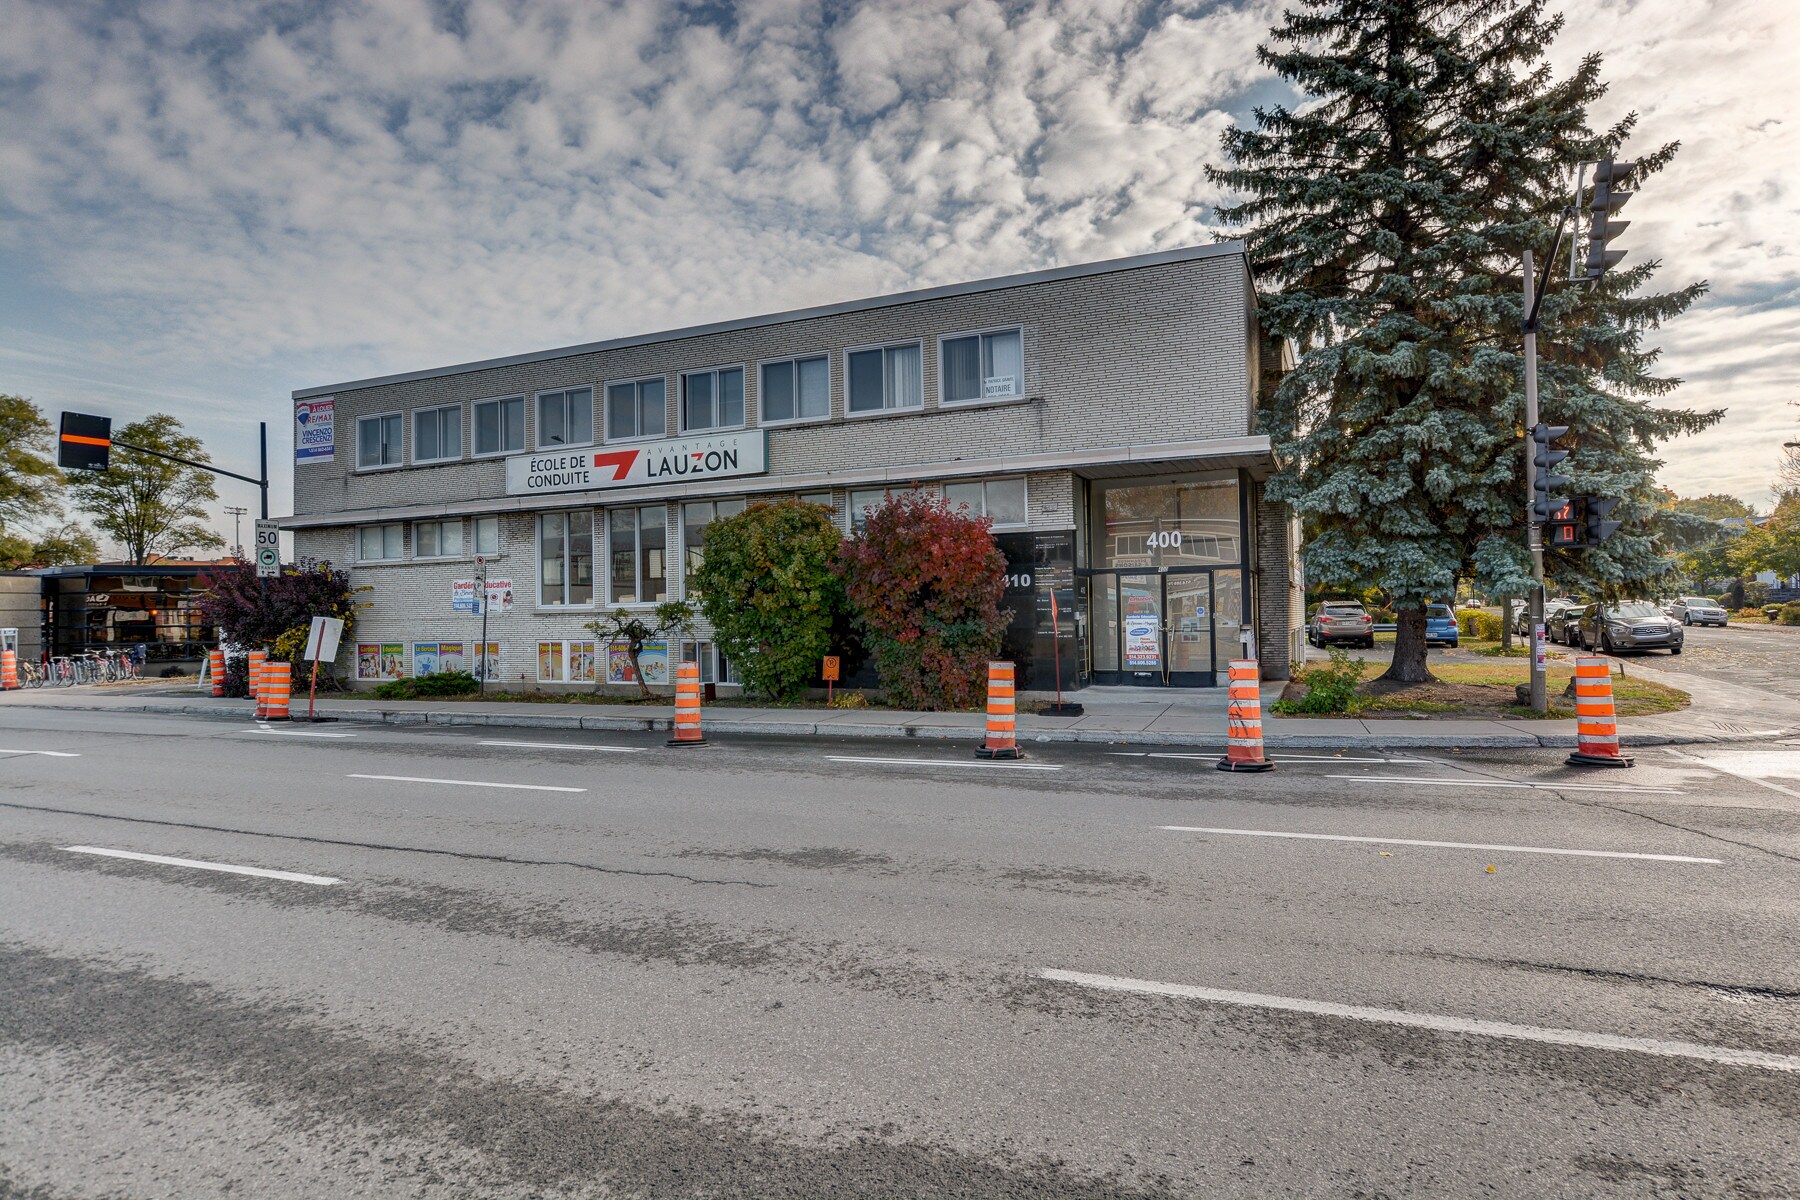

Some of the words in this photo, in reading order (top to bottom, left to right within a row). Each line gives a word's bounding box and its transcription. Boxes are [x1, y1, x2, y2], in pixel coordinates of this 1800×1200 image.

[986, 384, 1011, 394] NOTAIRE
[317, 404, 333, 412] LOUER
[307, 413, 332, 423] RE/MAX
[302, 427, 332, 437] VINCENZO
[302, 435, 332, 444] CRESCENZI
[647, 438, 738, 455] AVANTAGE
[530, 457, 567, 472] ÉCOLE
[570, 455, 586, 469] DE
[647, 449, 738, 478] LAUZON
[527, 471, 590, 488] CONDUITE
[258, 531, 277, 544] 50
[1146, 530, 1182, 548] 400
